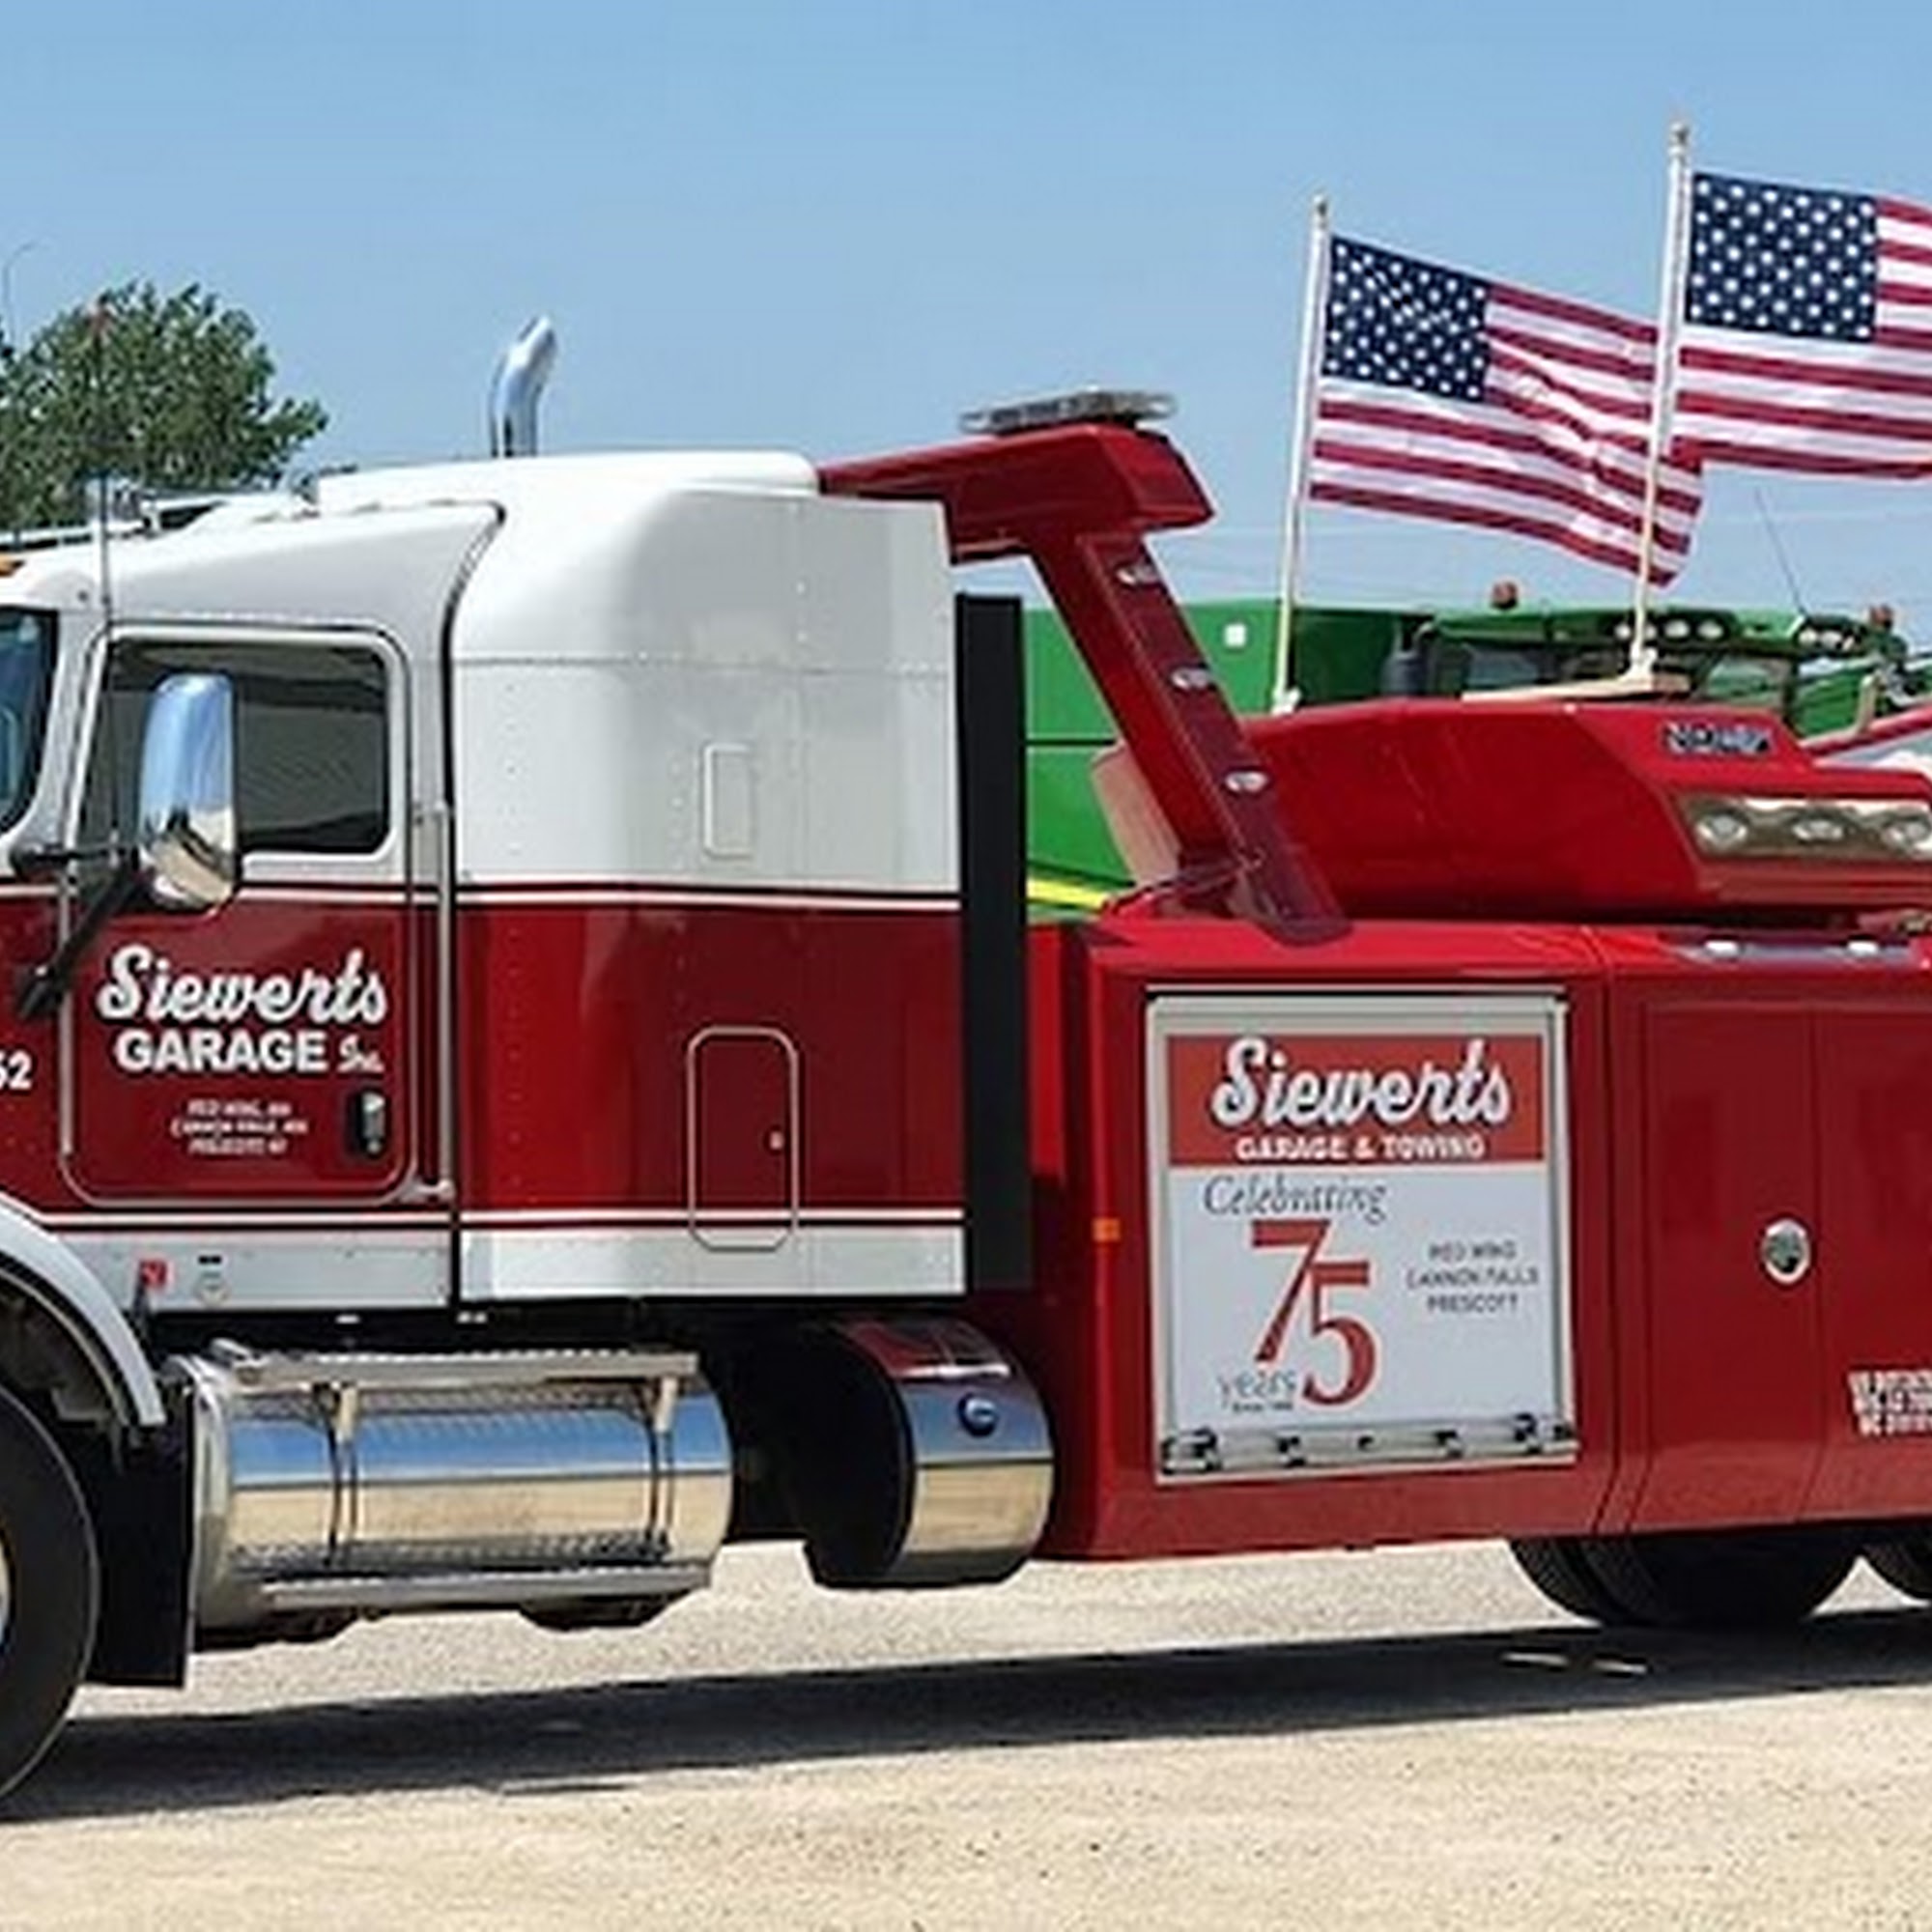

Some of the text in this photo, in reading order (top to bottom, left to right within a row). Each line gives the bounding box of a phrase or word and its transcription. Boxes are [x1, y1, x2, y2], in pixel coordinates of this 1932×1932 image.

[97, 944, 387, 1024] Siewerts
[113, 1030, 327, 1073] GARAGE
[1211, 1037, 1511, 1126] Siewerts
[1235, 1133, 1486, 1160] GARAGE & TOWING
[1204, 1173, 1388, 1226] Celebrating
[1250, 1218, 1378, 1406] 75
